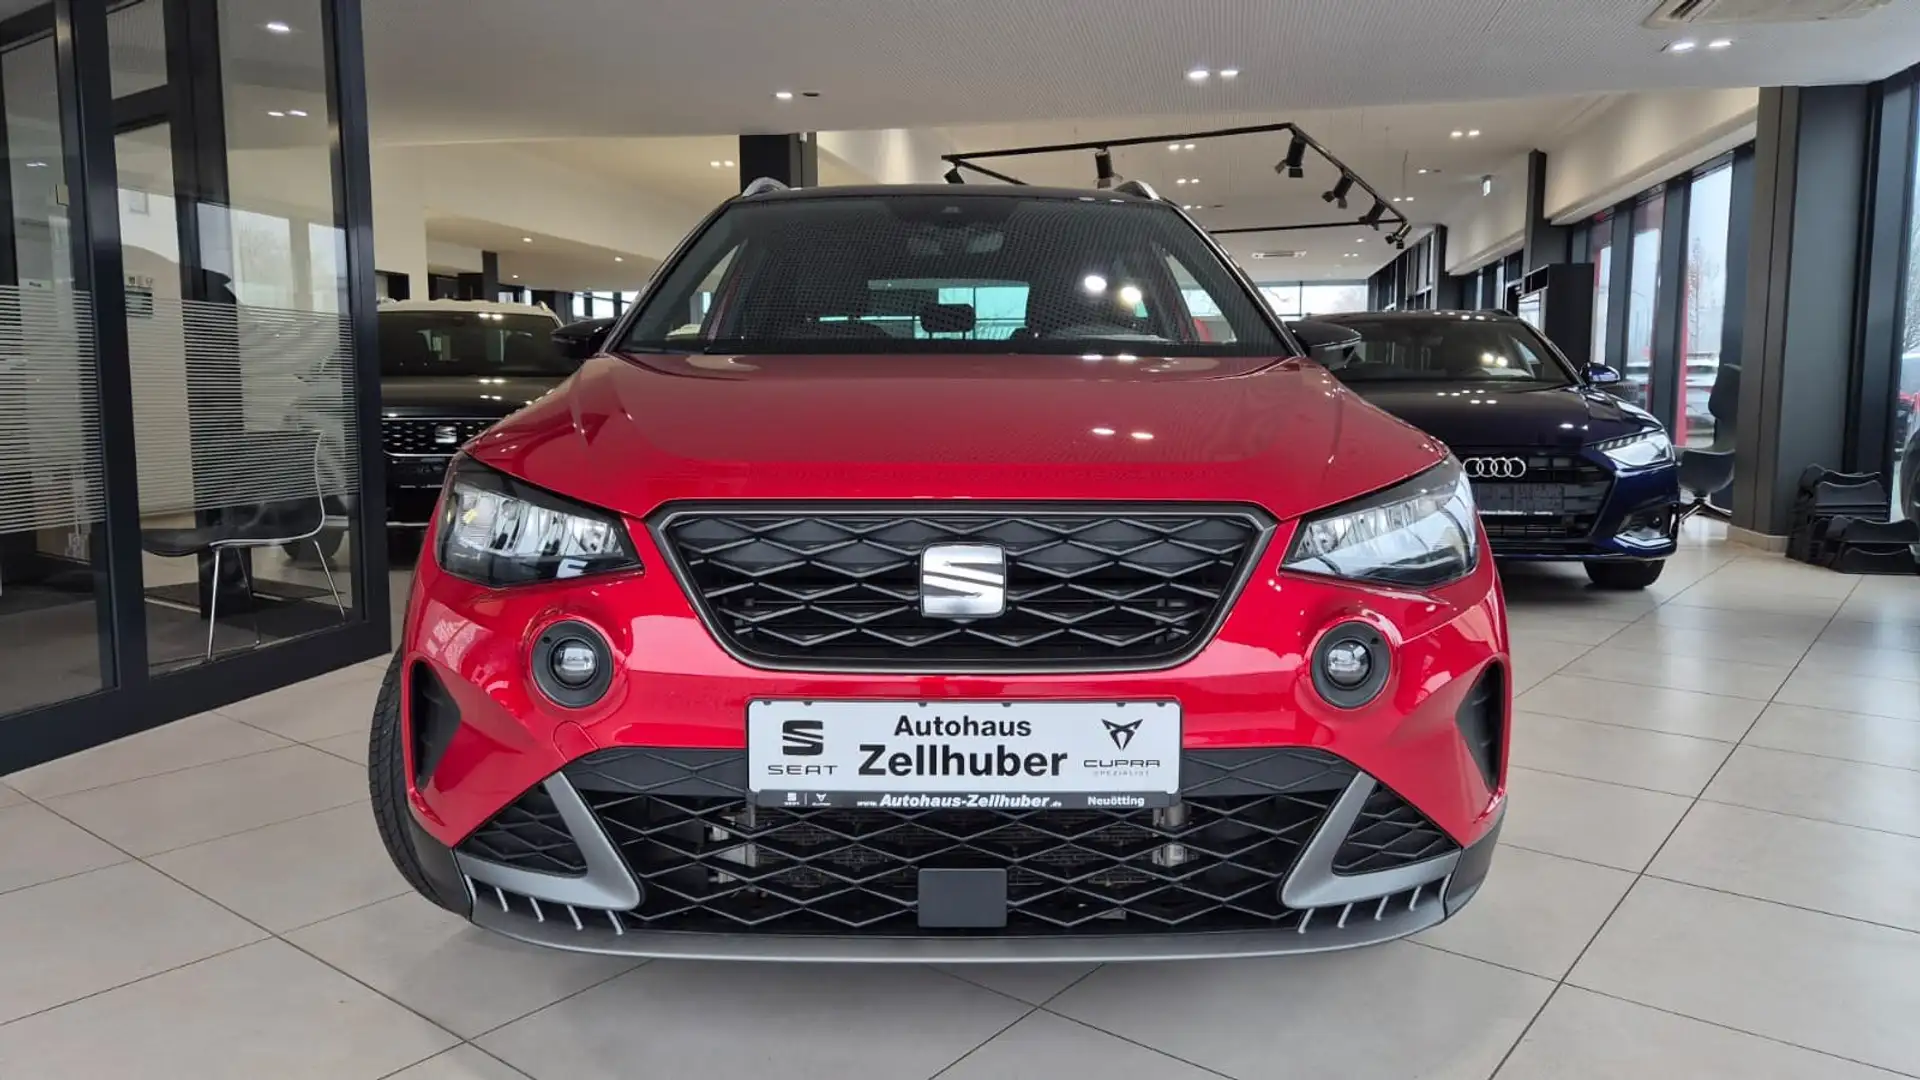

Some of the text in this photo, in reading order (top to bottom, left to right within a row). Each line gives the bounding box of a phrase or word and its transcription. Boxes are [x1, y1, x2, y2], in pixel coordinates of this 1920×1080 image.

[894, 715, 1032, 737] Autohaus
[858, 744, 1068, 776] Zellhuber
[1084, 759, 1160, 768] CUPRA
[768, 765, 838, 775] SEAT
[1087, 795, 1145, 807] Neuötting
